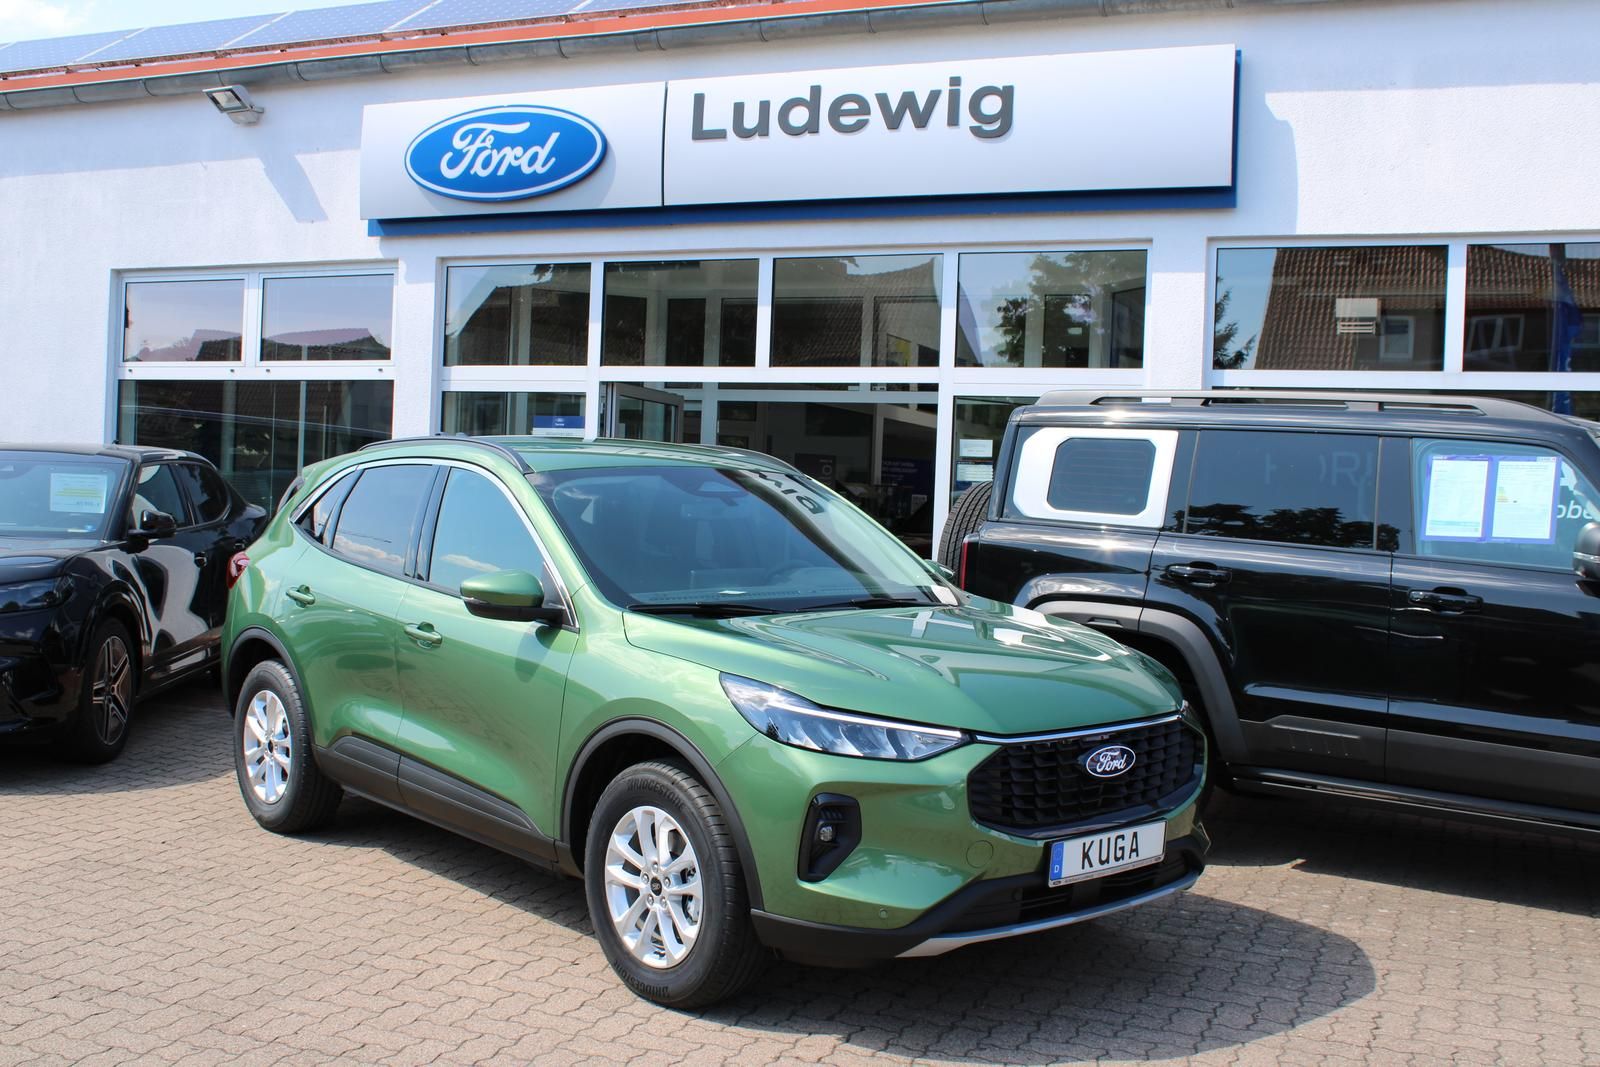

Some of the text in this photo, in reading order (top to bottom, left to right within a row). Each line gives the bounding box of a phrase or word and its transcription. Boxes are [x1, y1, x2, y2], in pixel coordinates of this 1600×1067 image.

[691, 76, 1015, 140] Ludewig
[440, 122, 560, 179] Ford
[1096, 751, 1127, 773] Ford
[1054, 864, 1060, 873] D
[1081, 831, 1140, 870] KUGA
